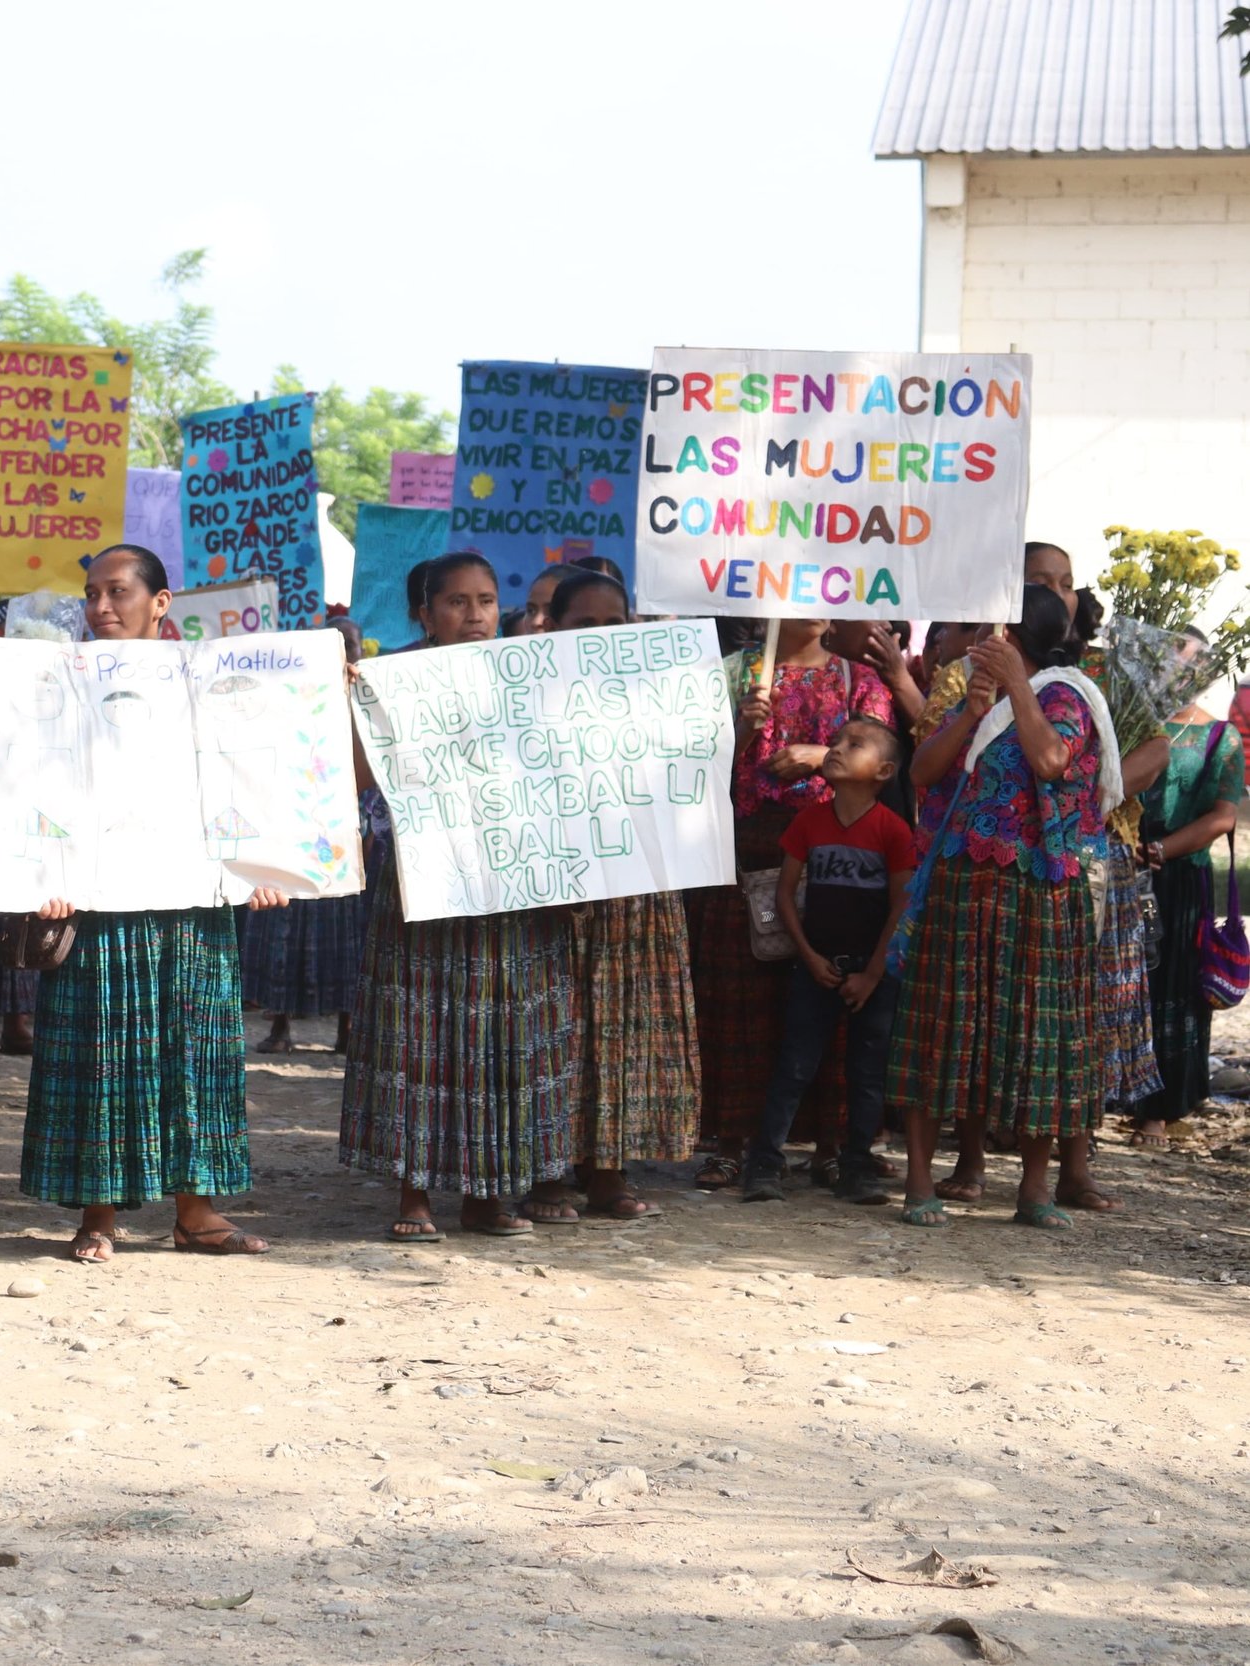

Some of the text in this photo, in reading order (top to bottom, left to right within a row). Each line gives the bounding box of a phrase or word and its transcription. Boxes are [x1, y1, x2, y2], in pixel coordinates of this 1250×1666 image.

[464, 370, 521, 396] LAS
[650, 366, 1022, 419] PRESENTACIÓN
[63, 389, 100, 413] LA
[65, 421, 122, 447] POR
[190, 403, 302, 448] PRESENTE
[469, 407, 642, 442] QUEREMOS
[236, 437, 269, 465] LA
[459, 443, 632, 474] VIVIR EN PAZ
[645, 434, 996, 483] LAS MUJERES
[186, 449, 314, 497] COMUNIDAD
[4, 482, 59, 506] LAS
[190, 488, 309, 528] RIO ZARCO
[511, 479, 581, 505] Y EN
[205, 518, 299, 554] GRANDE
[452, 507, 625, 537] DEMOCRACIA
[650, 496, 931, 545] COMUNIDAD
[233, 549, 283, 574] LAS
[700, 558, 901, 605] VENECIA
[220, 604, 273, 637] POR
[668, 763, 705, 804] LI
[590, 816, 633, 858] LI
[812, 851, 855, 880] ike
